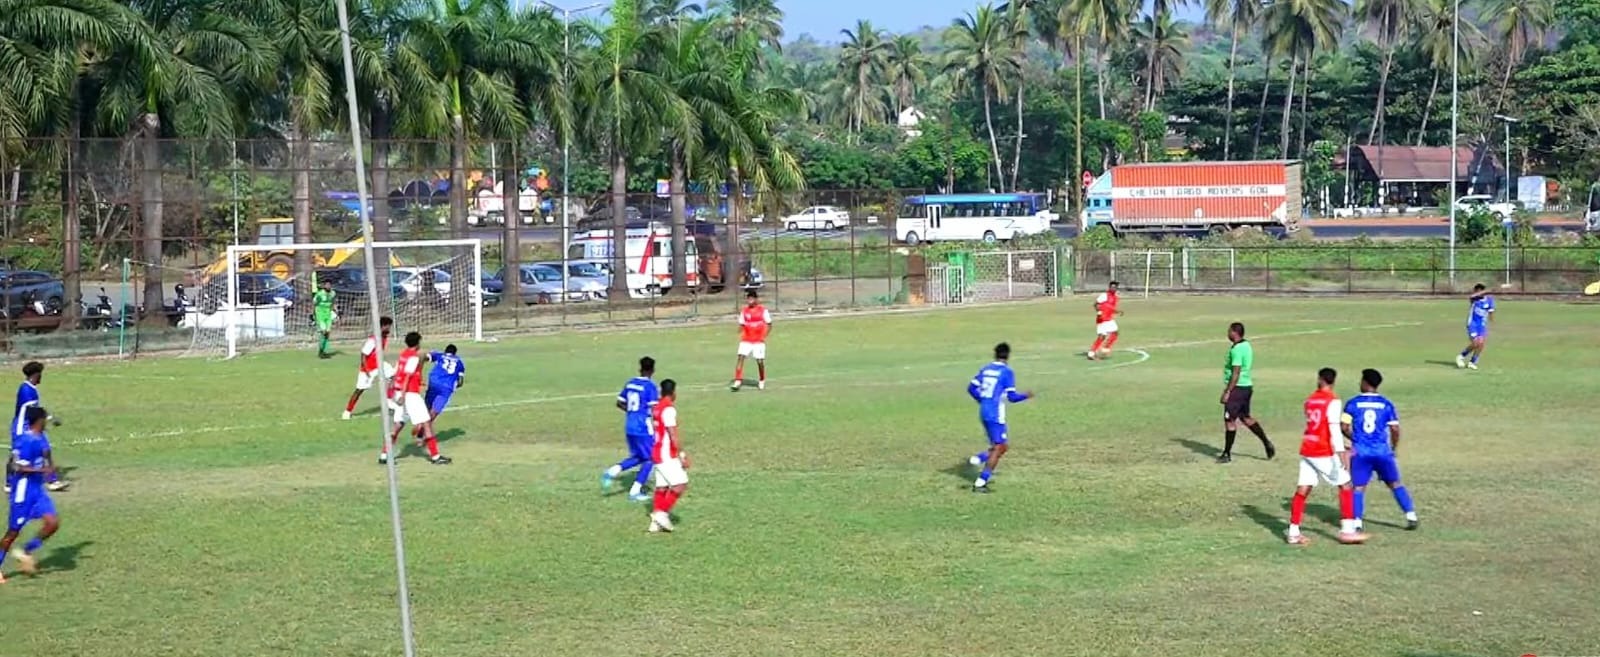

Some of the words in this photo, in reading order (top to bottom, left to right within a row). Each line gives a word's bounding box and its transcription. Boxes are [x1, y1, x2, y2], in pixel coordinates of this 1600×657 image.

[1208, 187, 1244, 195] MOVERS
[1250, 186, 1269, 195] GOA
[1363, 409, 1377, 434] 8
